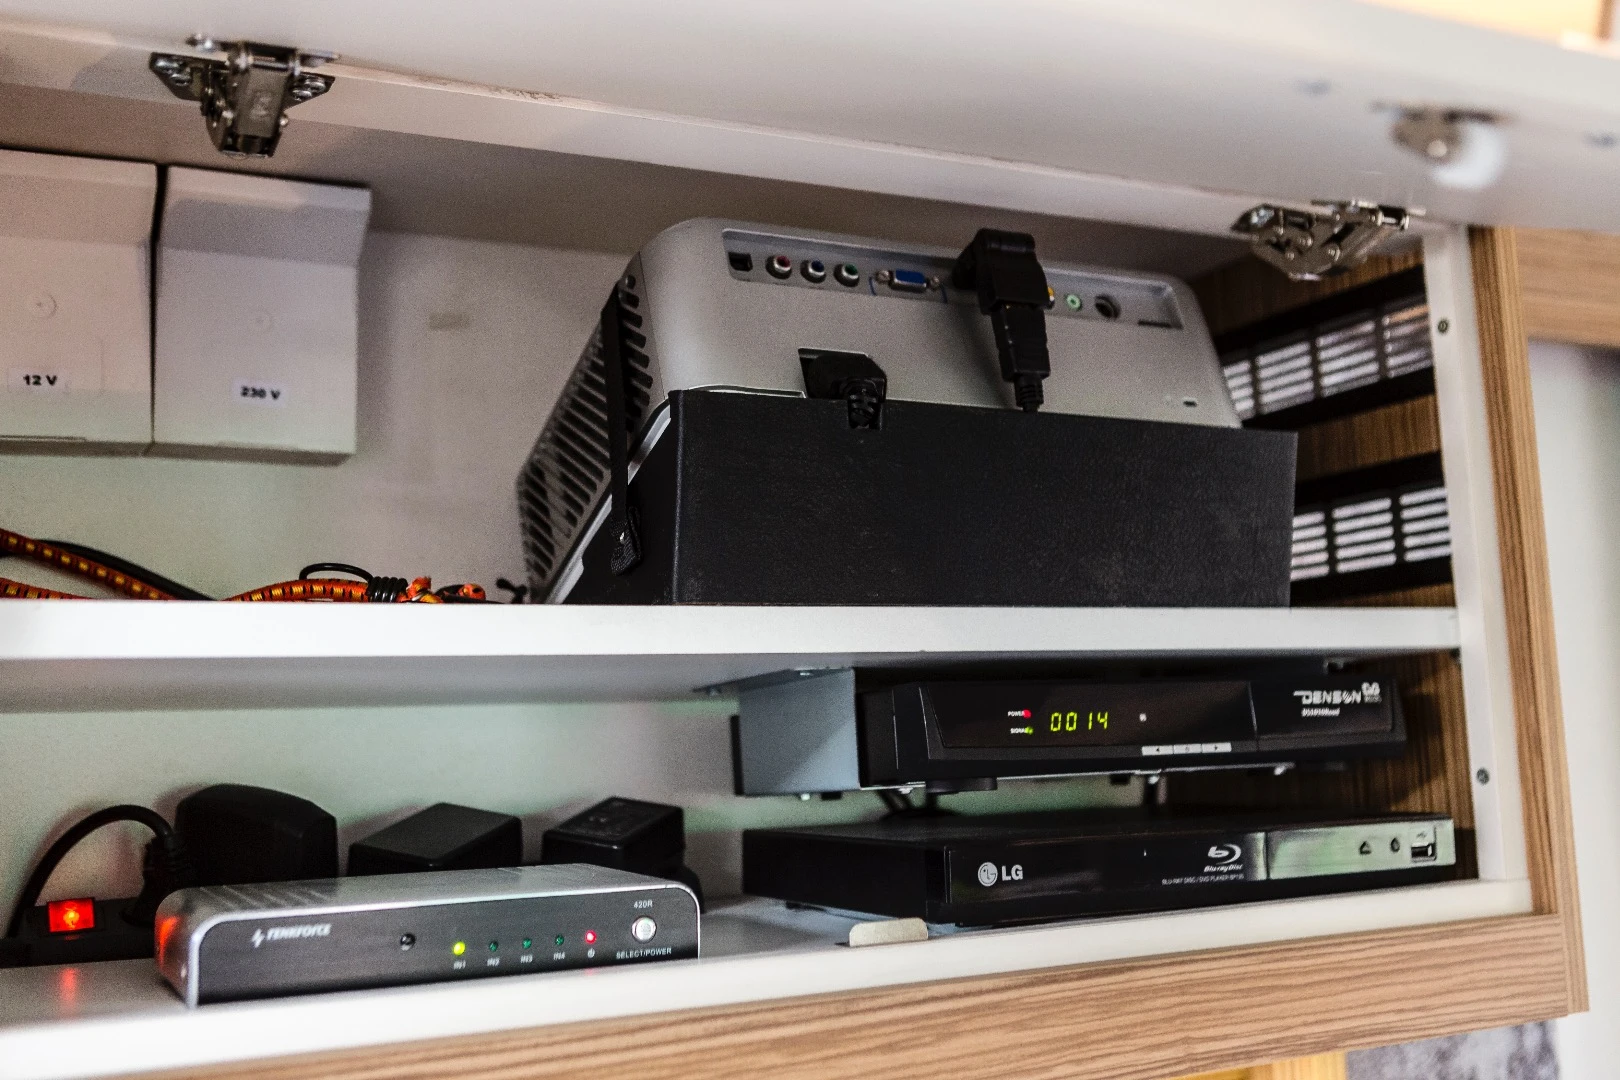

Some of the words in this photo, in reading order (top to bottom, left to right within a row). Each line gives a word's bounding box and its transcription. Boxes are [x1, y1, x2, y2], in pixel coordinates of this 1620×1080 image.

[23, 374, 42, 386] 12
[46, 375, 57, 386] V
[240, 386, 267, 399] 230
[271, 389, 280, 400] V
[1001, 864, 1023, 881] LG
[633, 899, 653, 909] 420R
[616, 947, 672, 960] SELECT/POWER
